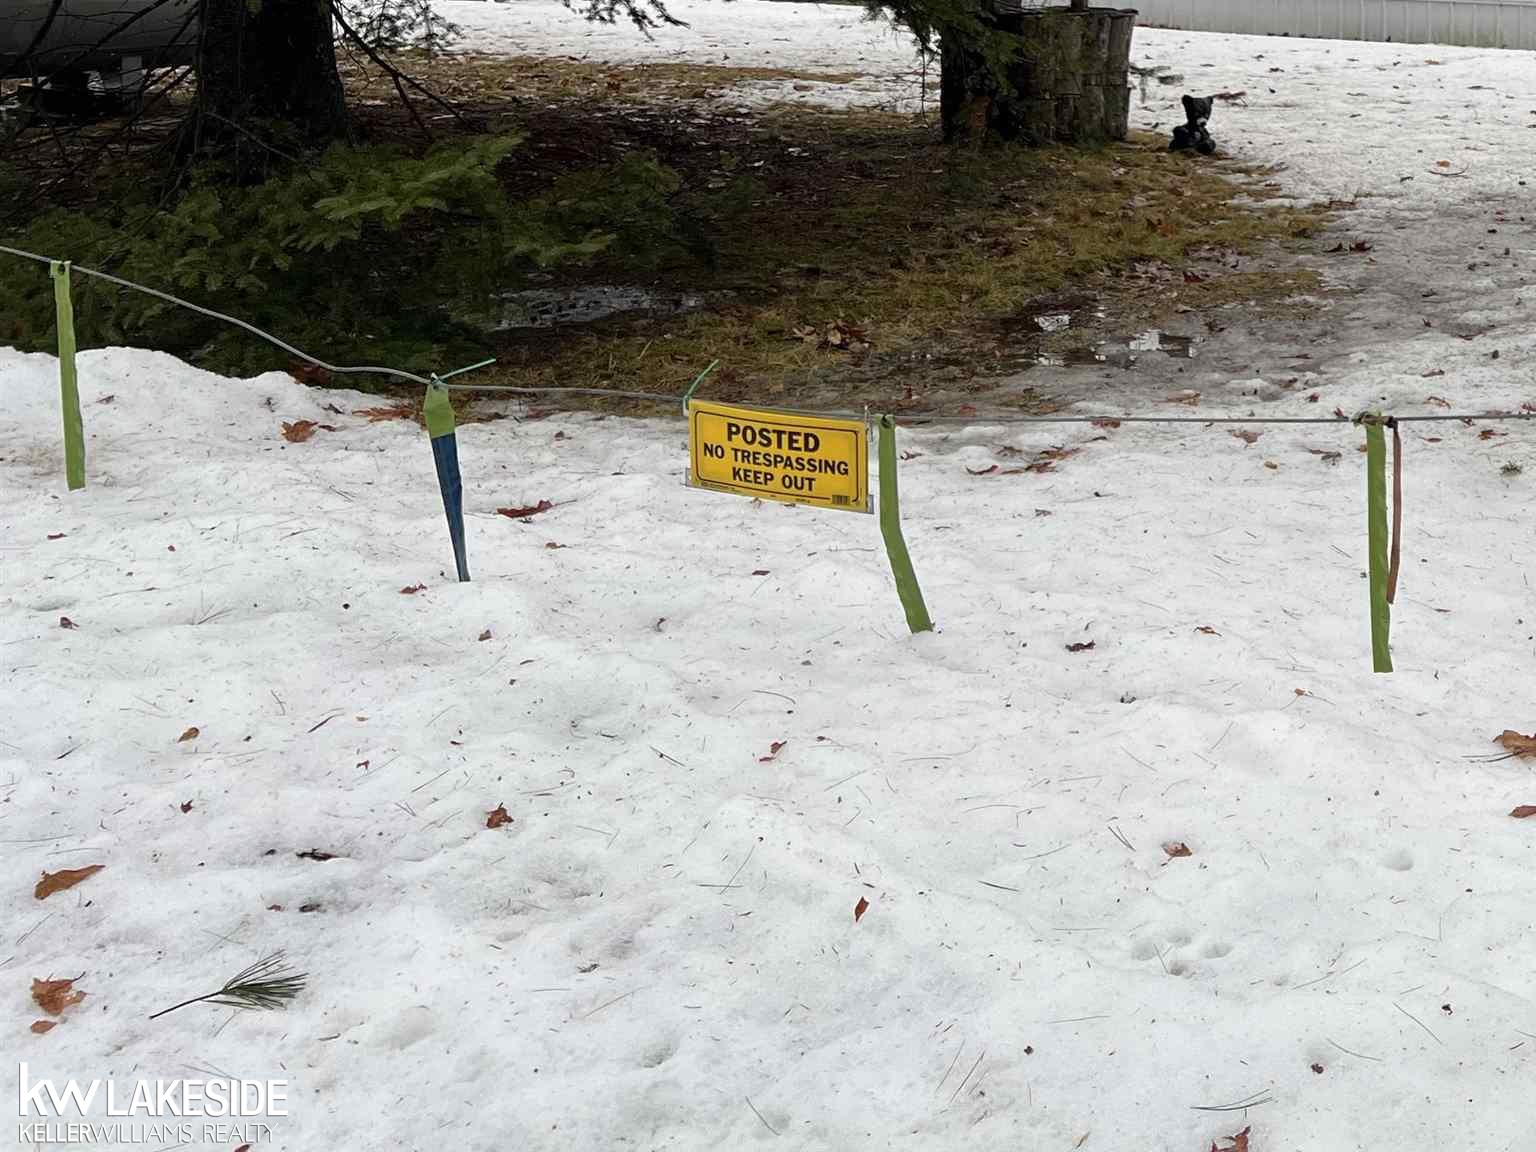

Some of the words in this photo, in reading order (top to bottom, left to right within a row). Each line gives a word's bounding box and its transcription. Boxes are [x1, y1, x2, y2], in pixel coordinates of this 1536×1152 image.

[726, 422, 821, 453] POSTED
[703, 442, 725, 459] NO
[731, 448, 849, 476] TRESPASSING
[732, 467, 775, 486] KEEP
[781, 474, 816, 492] OUT
